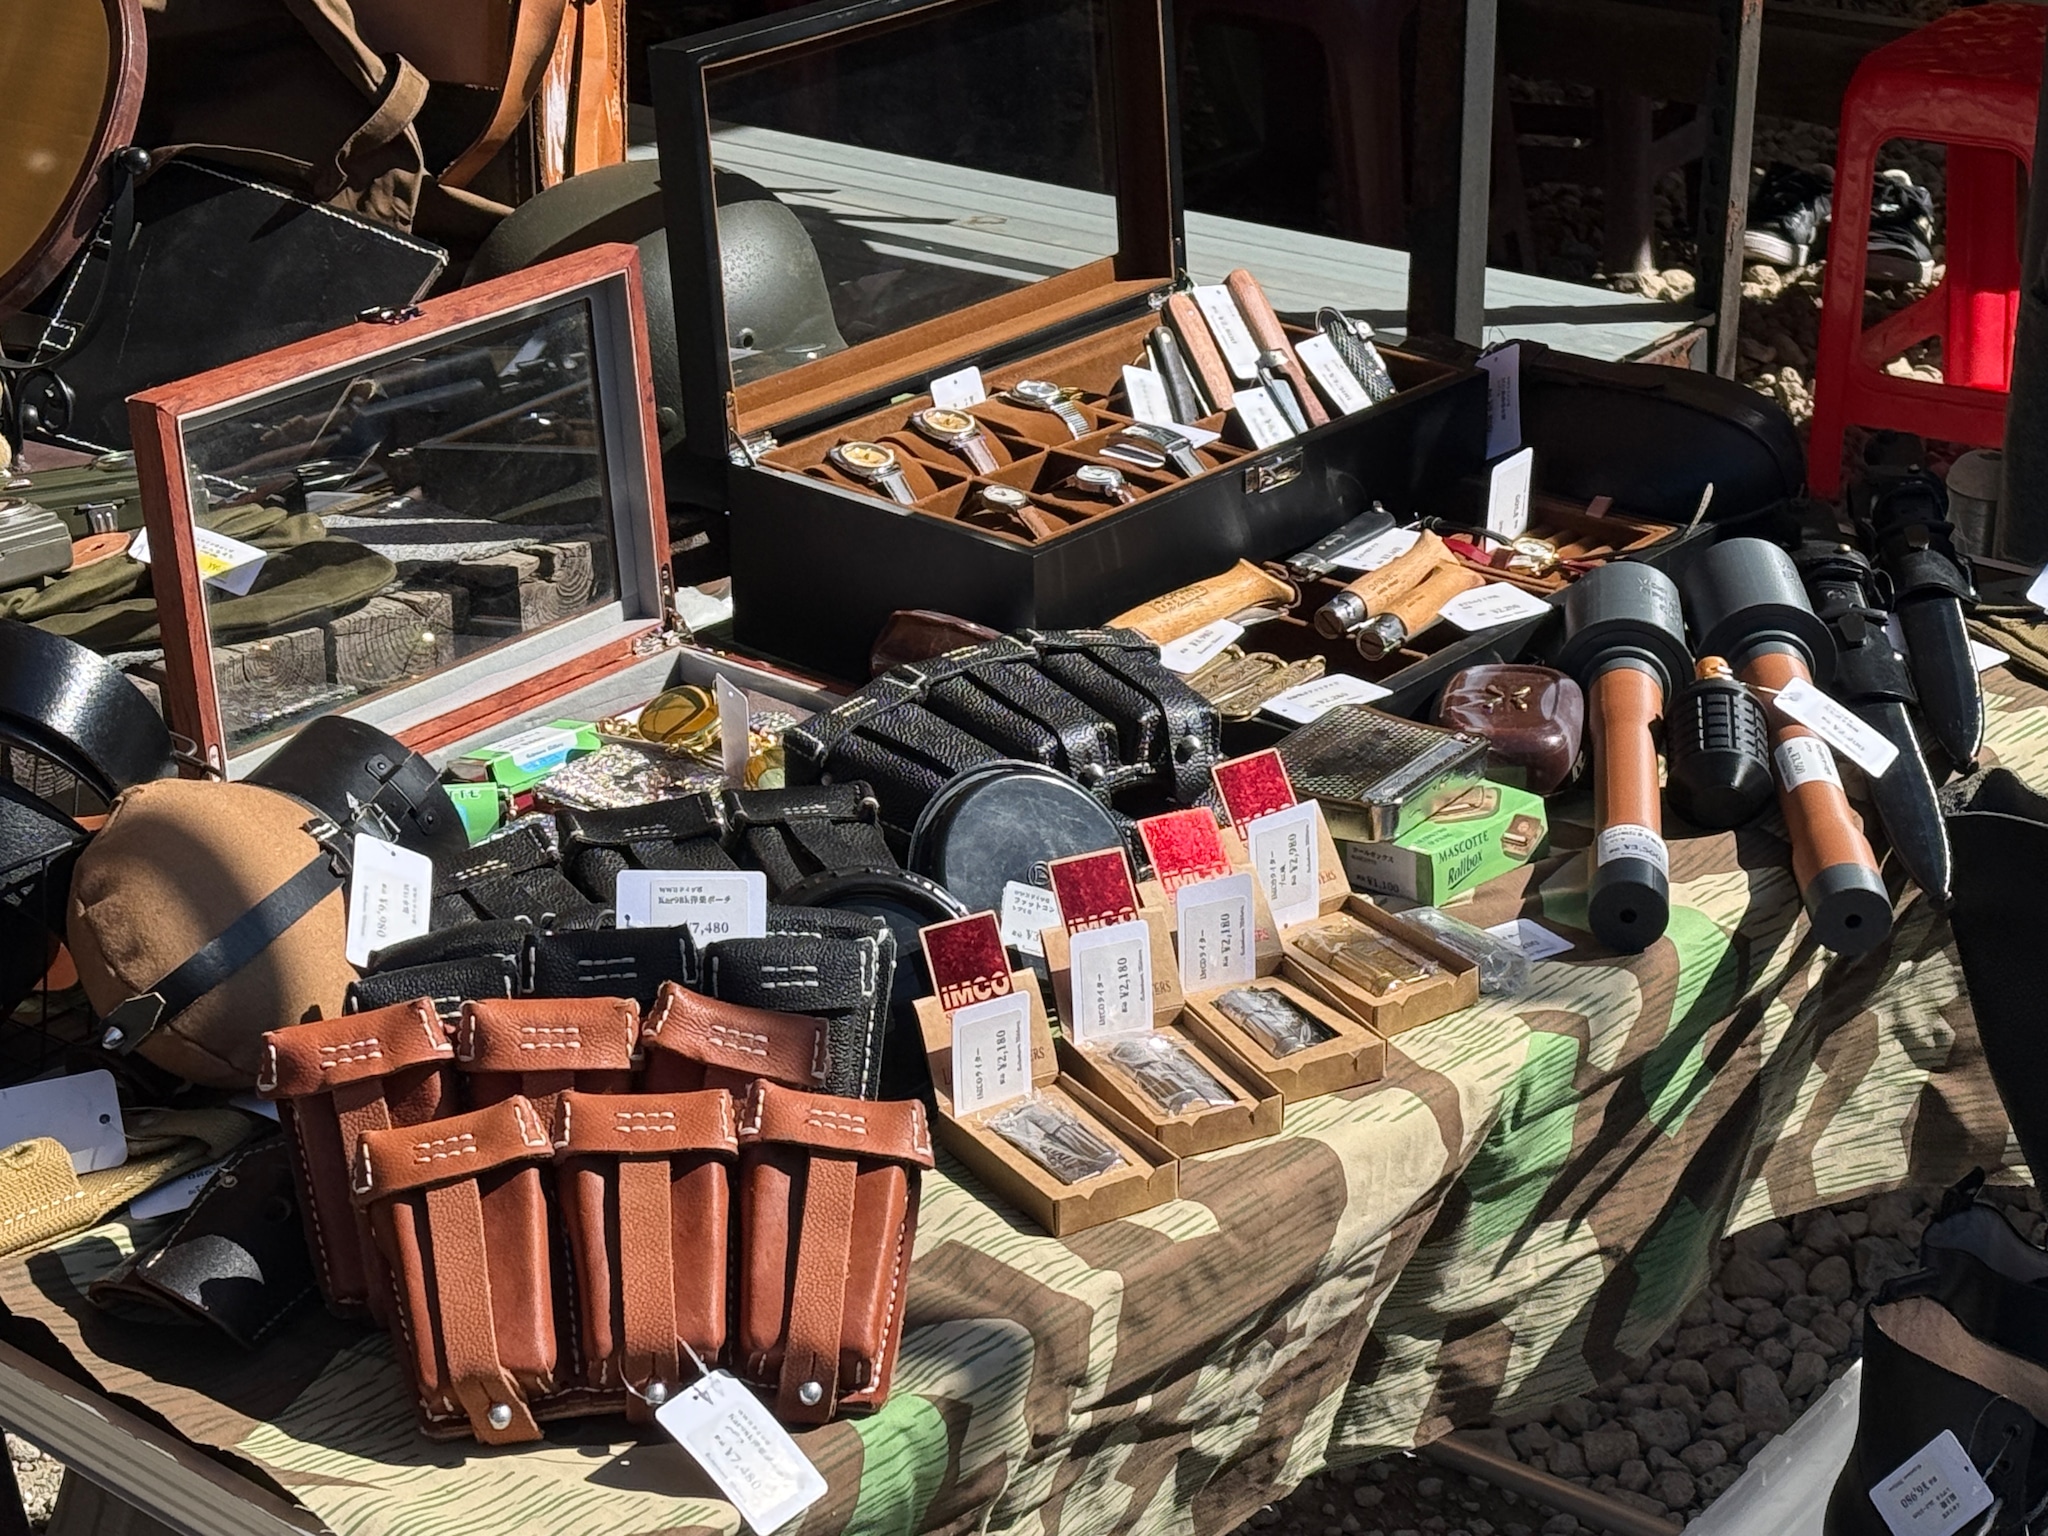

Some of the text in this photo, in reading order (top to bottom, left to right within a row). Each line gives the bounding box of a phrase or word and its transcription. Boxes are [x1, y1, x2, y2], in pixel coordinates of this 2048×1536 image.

[1287, 833, 1300, 873] ¥2,980
[1438, 830, 1490, 864] MASCOTTE
[1447, 851, 1484, 885] Rollbox
[690, 921, 729, 935] 7,480
[1220, 913, 1232, 953] ¥2,180
[941, 971, 1010, 1010] IMCO
[1117, 957, 1131, 1000] ¥2,180
[996, 1029, 1009, 1071] ¥2,180
[1900, 1480, 1930, 1509] ¥6,980
